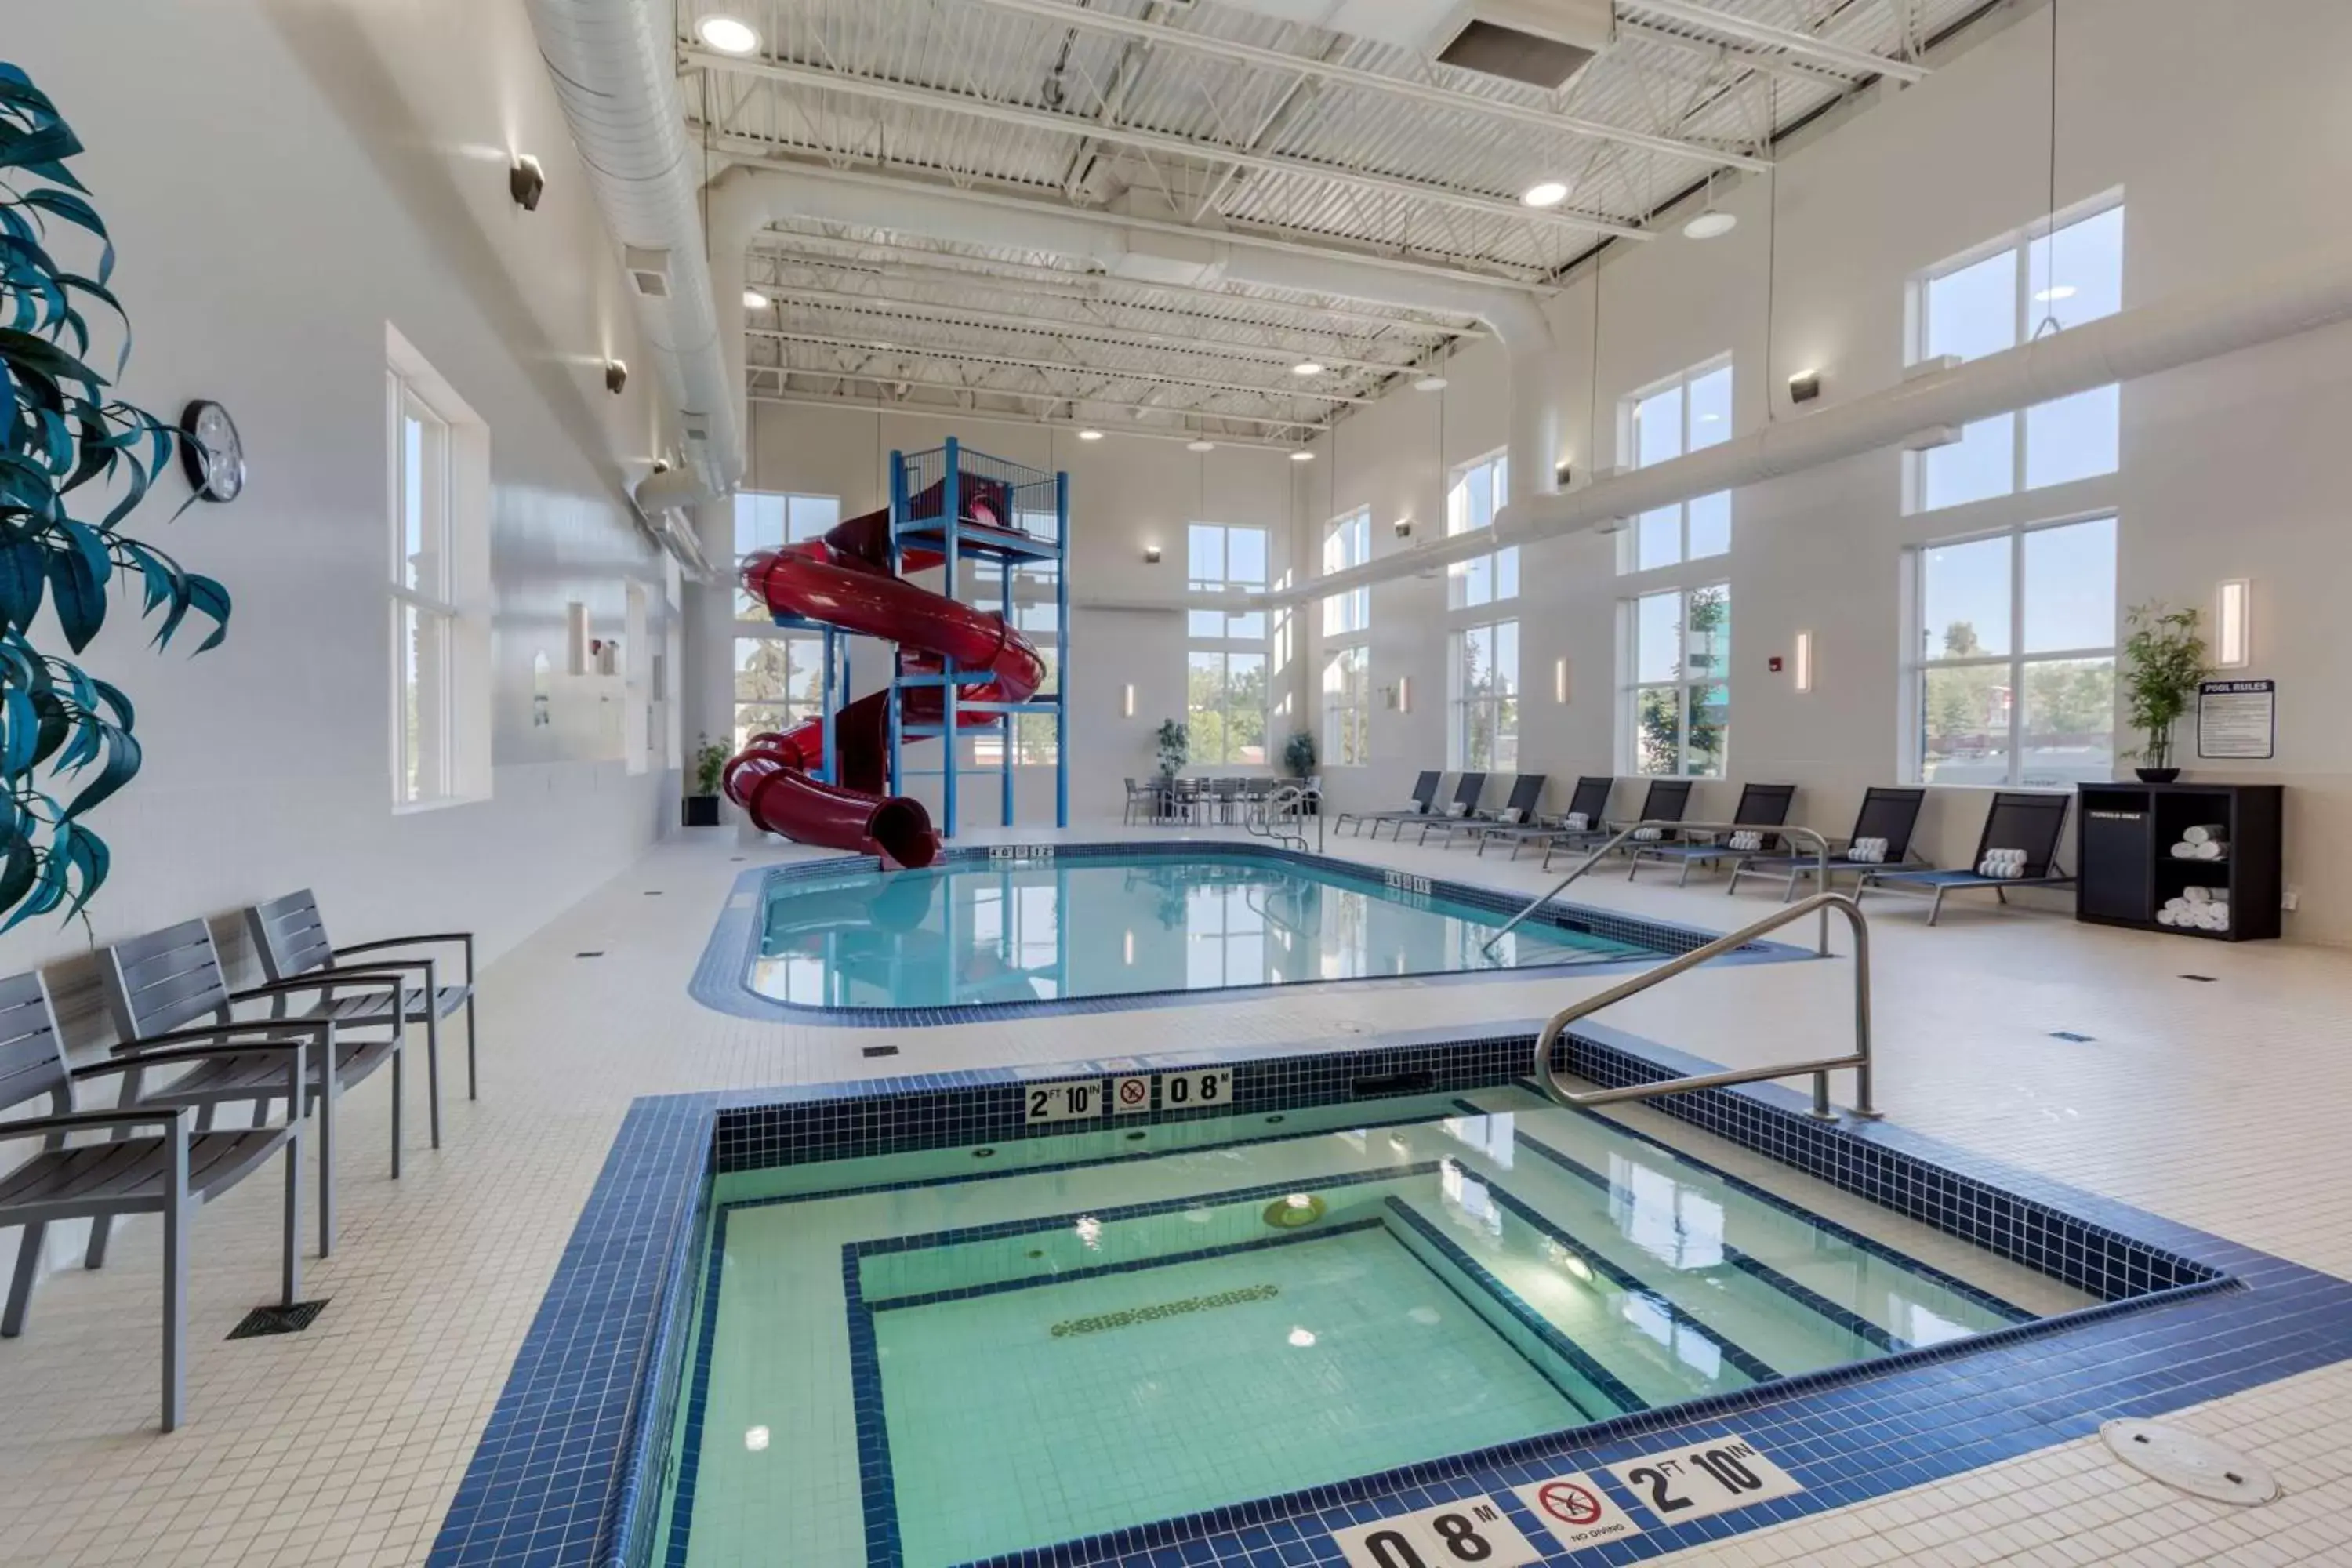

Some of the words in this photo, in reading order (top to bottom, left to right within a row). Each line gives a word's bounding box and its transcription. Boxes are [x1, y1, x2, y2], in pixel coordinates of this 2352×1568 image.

[2205, 684, 2230, 692] POOL
[2232, 681, 2269, 691] RULES
[1571, 1532, 1588, 1542] NO
[1589, 1523, 1625, 1537] DIVING
